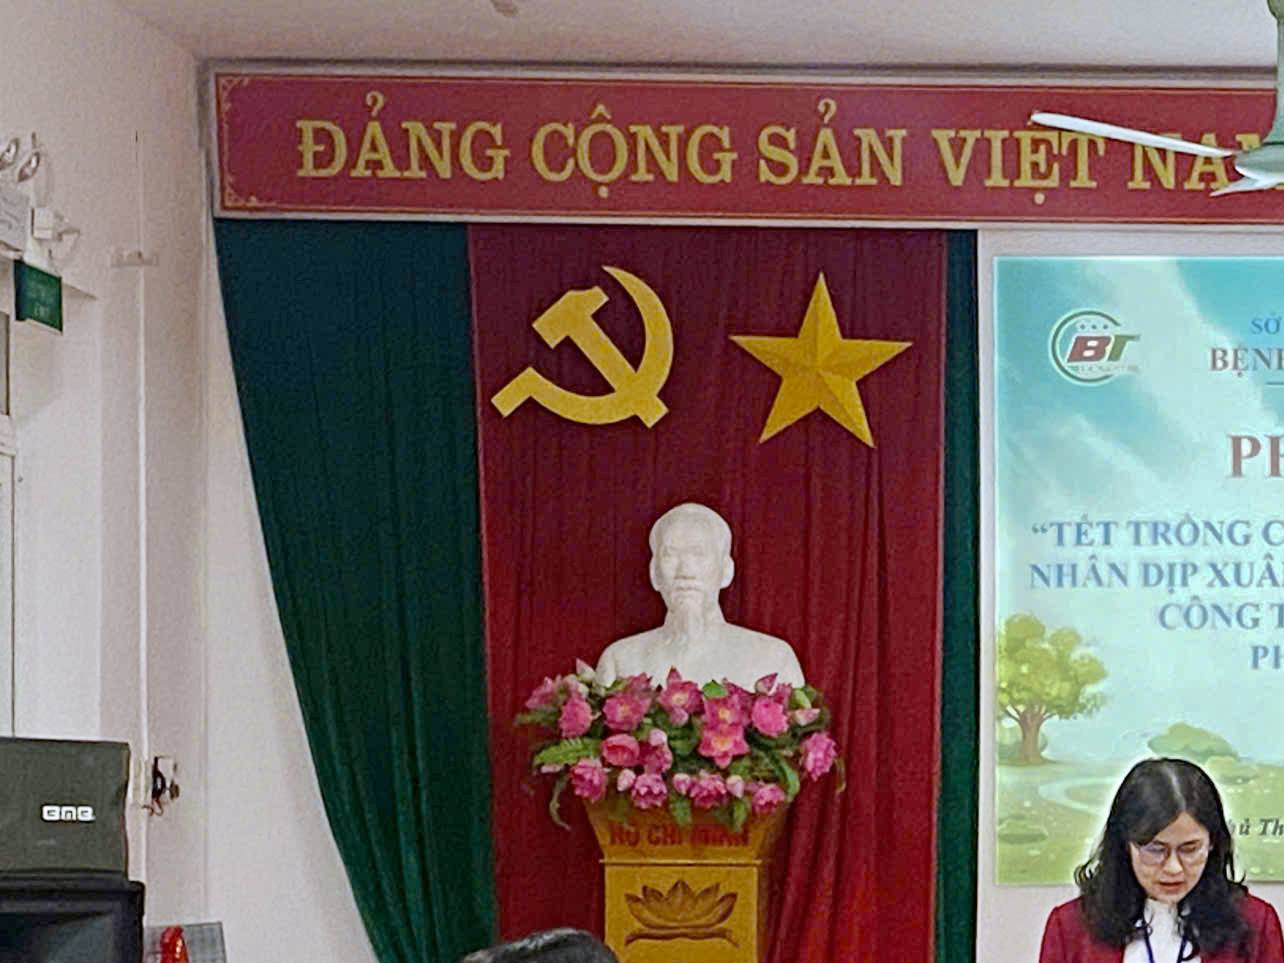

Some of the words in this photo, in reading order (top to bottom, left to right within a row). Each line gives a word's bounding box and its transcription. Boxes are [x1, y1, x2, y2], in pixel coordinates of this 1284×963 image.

[297, 92, 509, 180] ĐẢNG
[531, 104, 738, 198] CỘNG
[758, 98, 906, 186] SẢN
[931, 130, 1106, 205] VIỆT
[1030, 554, 1129, 588] NHÂN
[1141, 560, 1199, 595] DỊP
[1158, 595, 1261, 630] CÔNG
